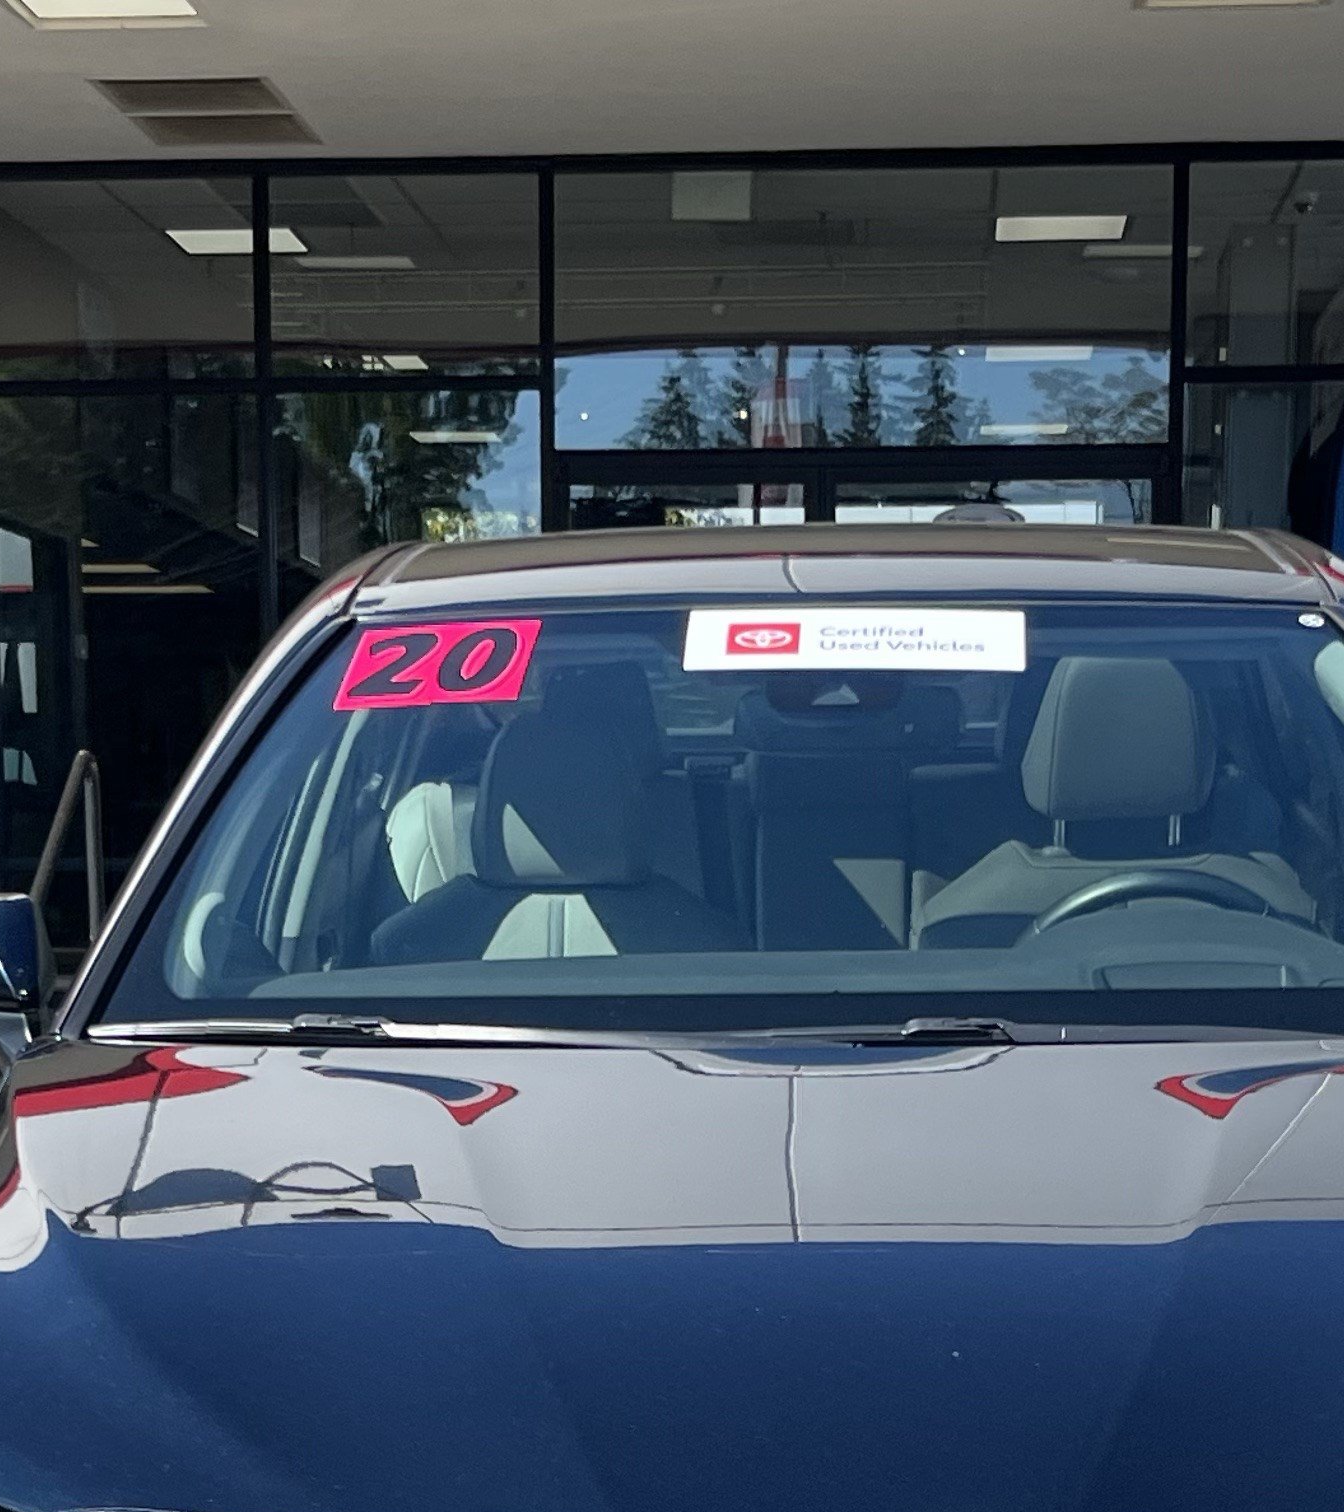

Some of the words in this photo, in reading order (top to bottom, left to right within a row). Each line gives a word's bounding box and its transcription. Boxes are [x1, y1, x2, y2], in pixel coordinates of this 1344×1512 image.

[820, 626, 924, 637] Certified
[819, 640, 879, 651] Used
[887, 640, 985, 652] Vehicles
[347, 628, 517, 697] 20
